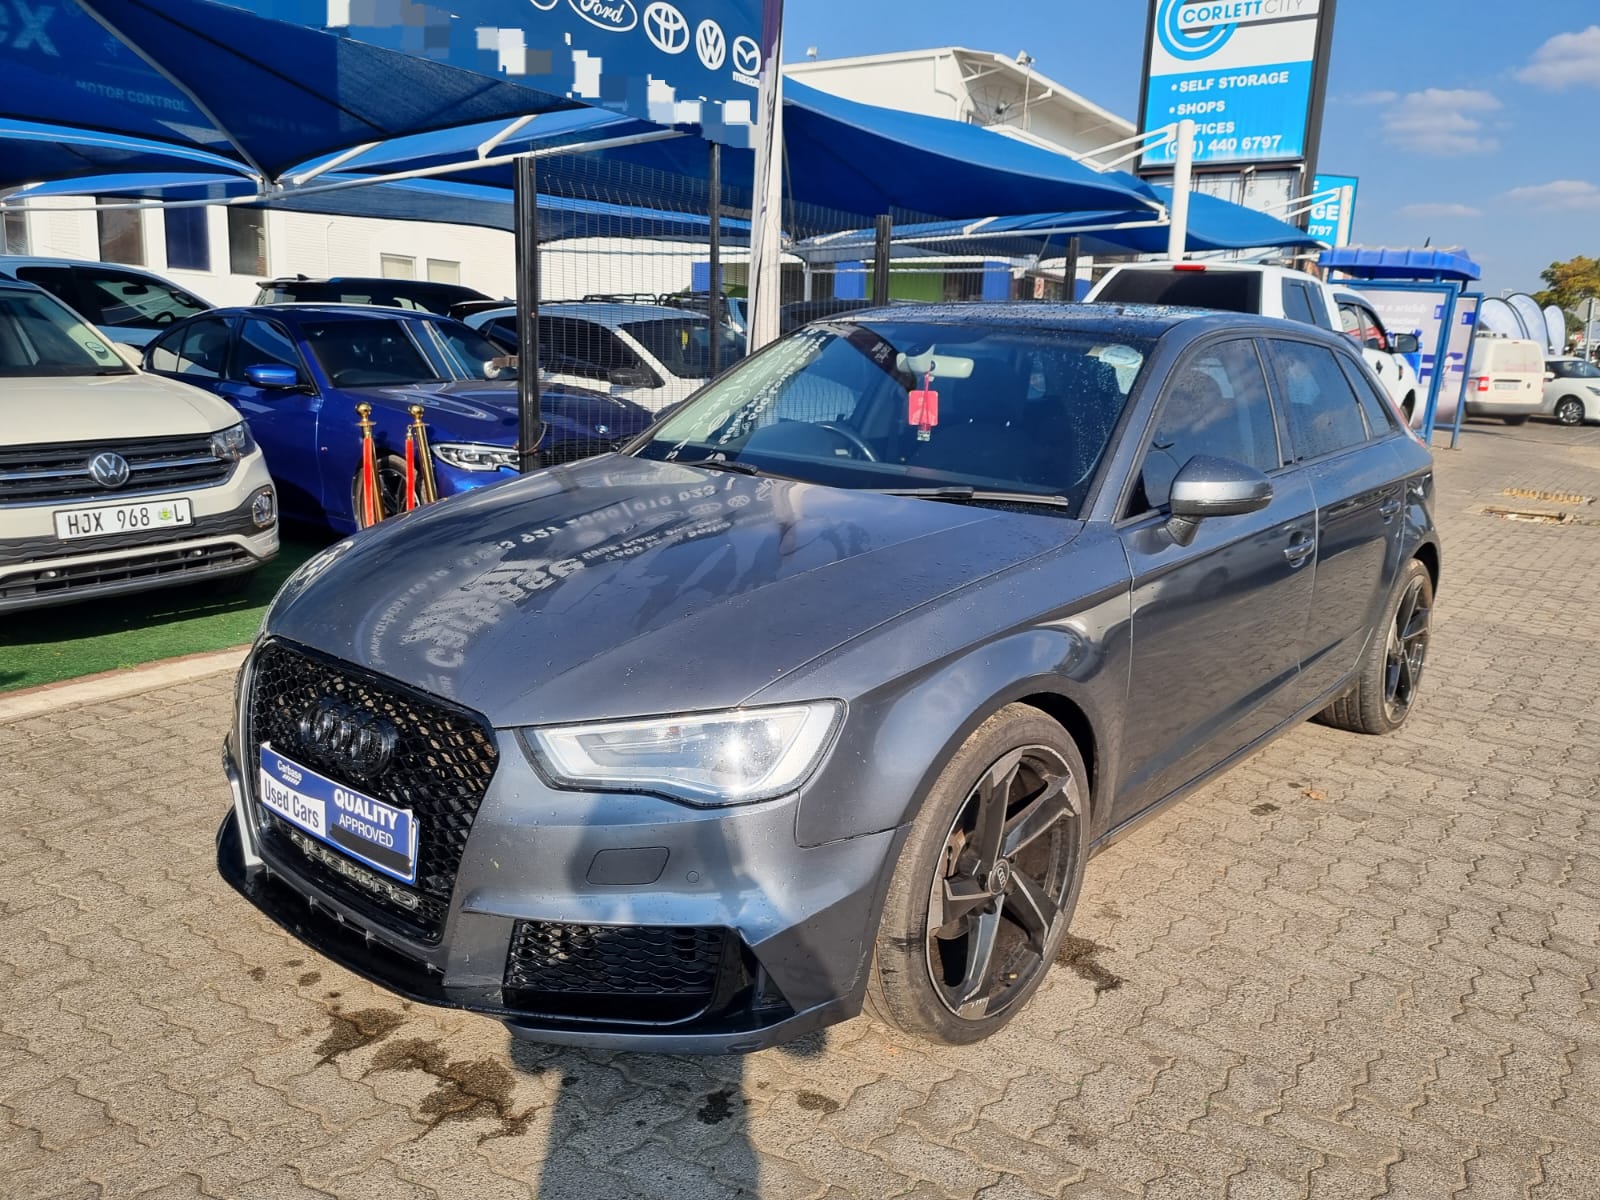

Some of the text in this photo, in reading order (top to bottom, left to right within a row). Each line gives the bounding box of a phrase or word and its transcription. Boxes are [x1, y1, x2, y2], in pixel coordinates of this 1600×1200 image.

[1179, 71, 1290, 93] SELF STORAGE
[127, 91, 191, 112] CONTROL
[1177, 101, 1226, 115] SHOPS
[1165, 135, 1282, 158] (01) 440 6797
[1310, 204, 1340, 221] GE
[67, 504, 184, 535] HJX 968 L
[264, 778, 320, 828] Used Cars
[333, 788, 398, 829] QUALITY
[338, 814, 394, 849] APPROVED
